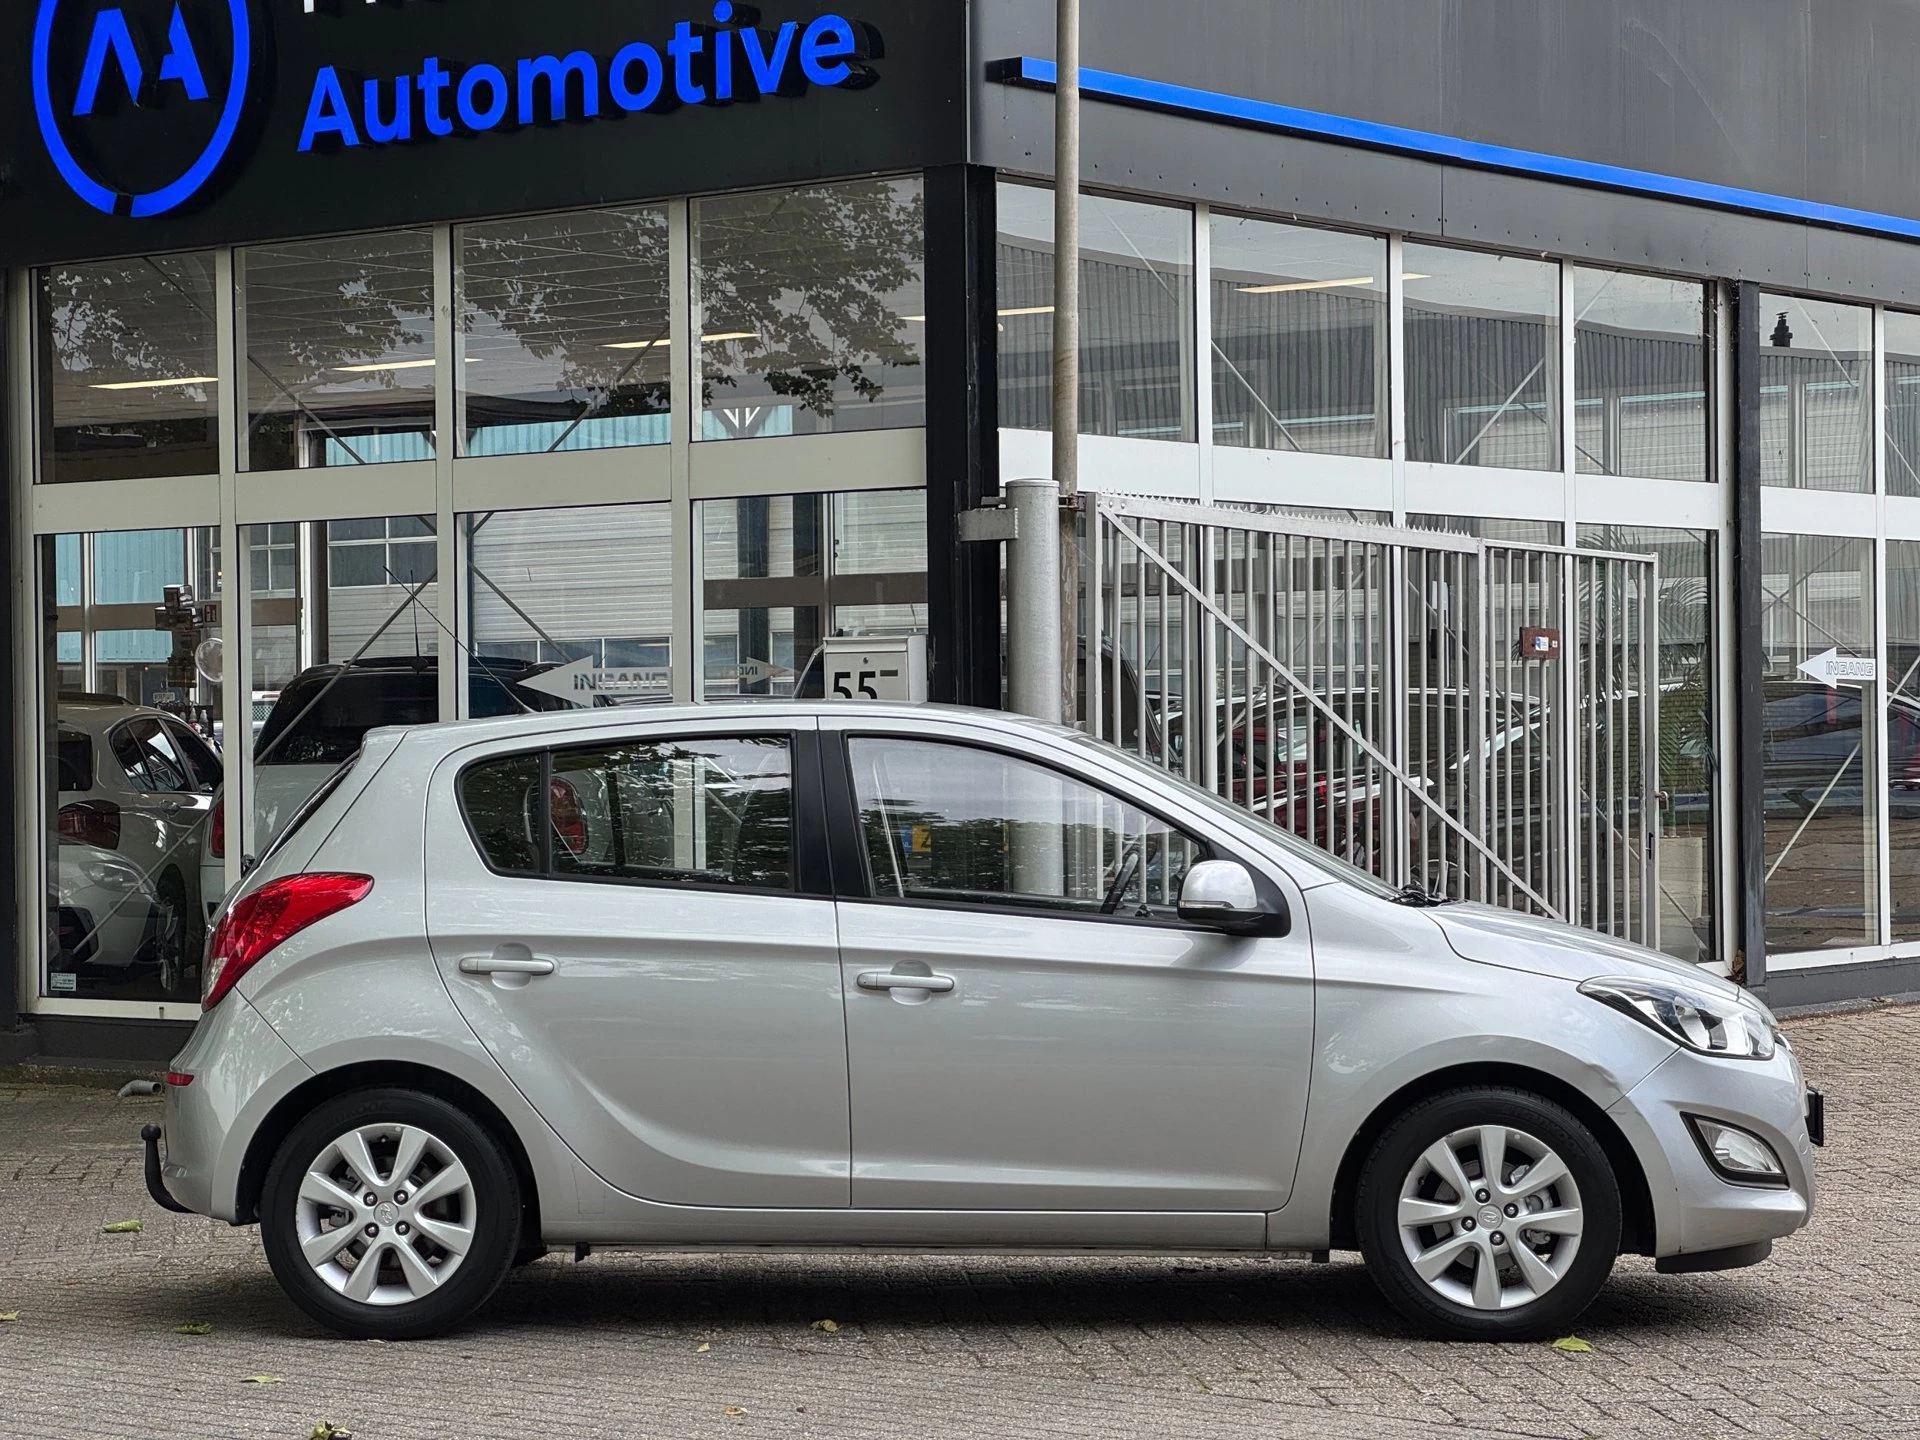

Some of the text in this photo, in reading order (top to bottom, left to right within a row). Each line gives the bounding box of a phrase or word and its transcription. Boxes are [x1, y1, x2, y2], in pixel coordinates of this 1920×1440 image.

[298, 0, 856, 152] Automotive
[1825, 660, 1874, 677] INGANG
[573, 671, 668, 691] INGANG
